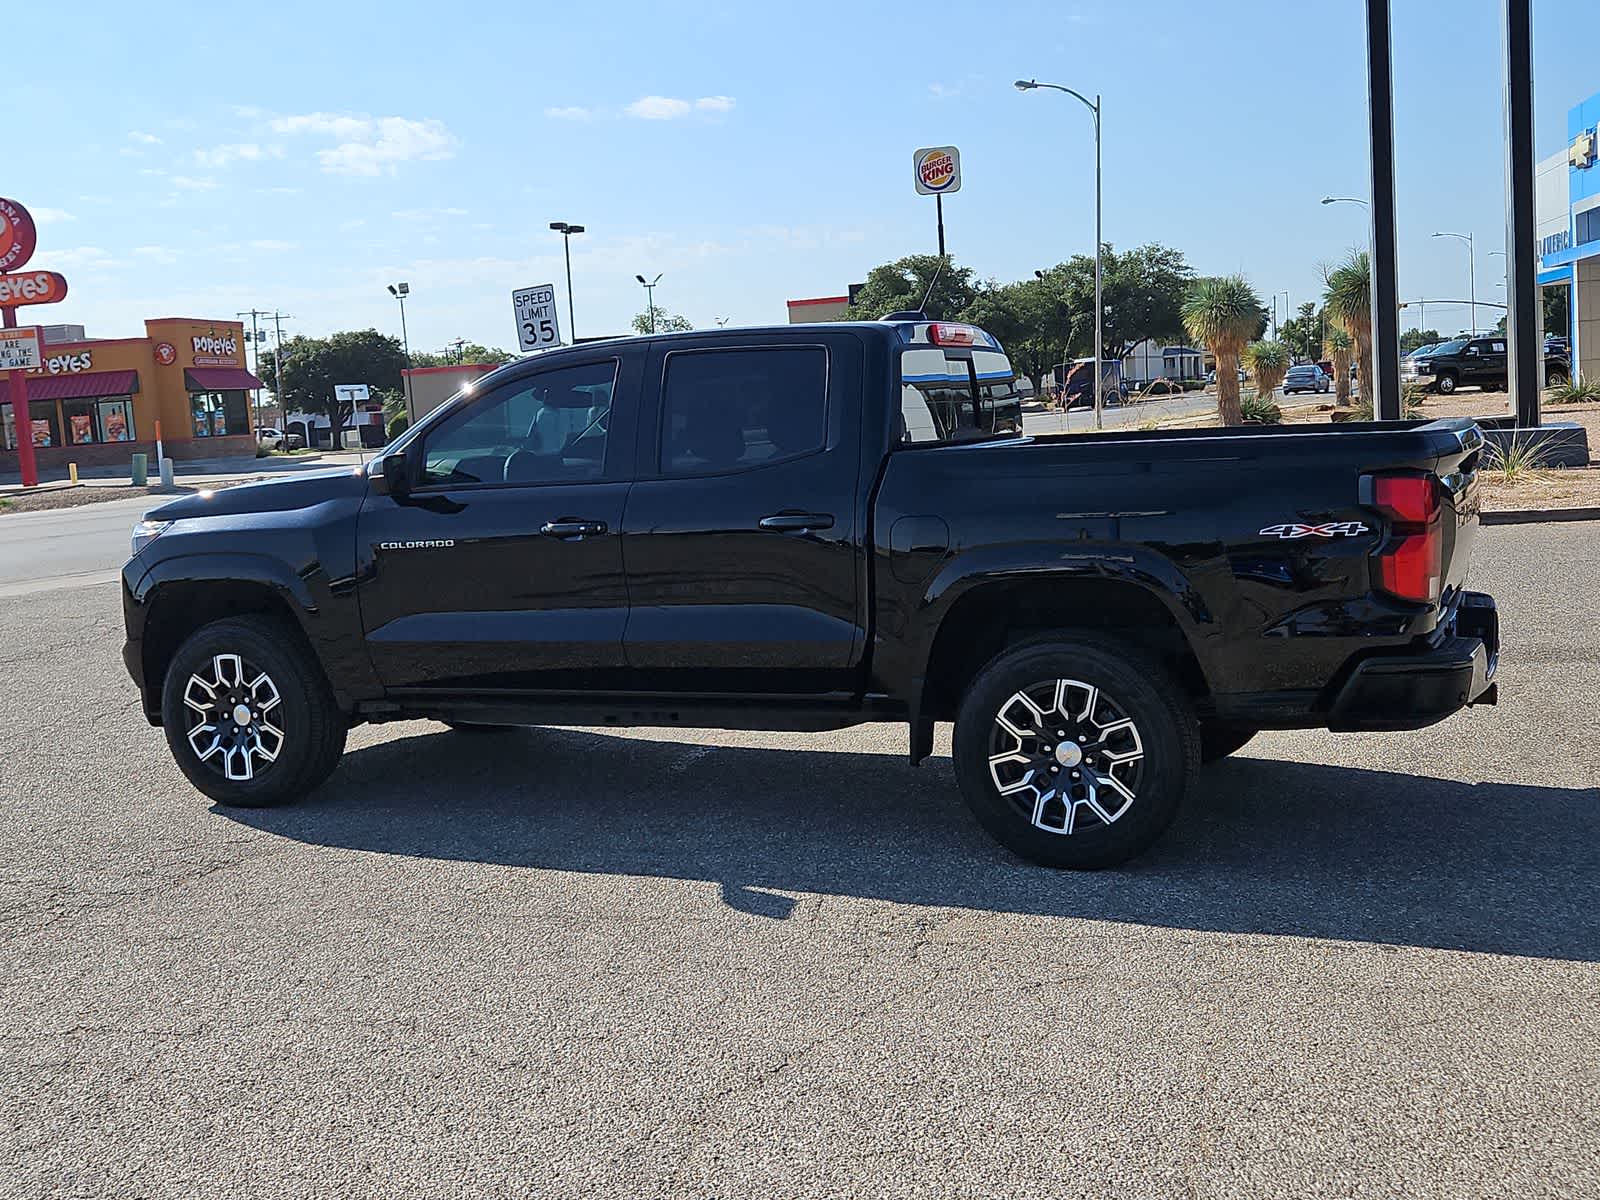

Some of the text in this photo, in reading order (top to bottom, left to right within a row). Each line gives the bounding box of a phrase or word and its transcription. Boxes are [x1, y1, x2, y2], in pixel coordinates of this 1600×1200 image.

[921, 155, 952, 174] BURGER
[923, 163, 953, 184] KING
[515, 290, 552, 308] SPEED
[521, 305, 549, 321] LIMIT
[523, 320, 555, 345] 35
[5, 340, 19, 349] ARE
[9, 357, 31, 367] GAME
[1259, 522, 1369, 539] 4X4
[380, 539, 455, 550] COLORADO
